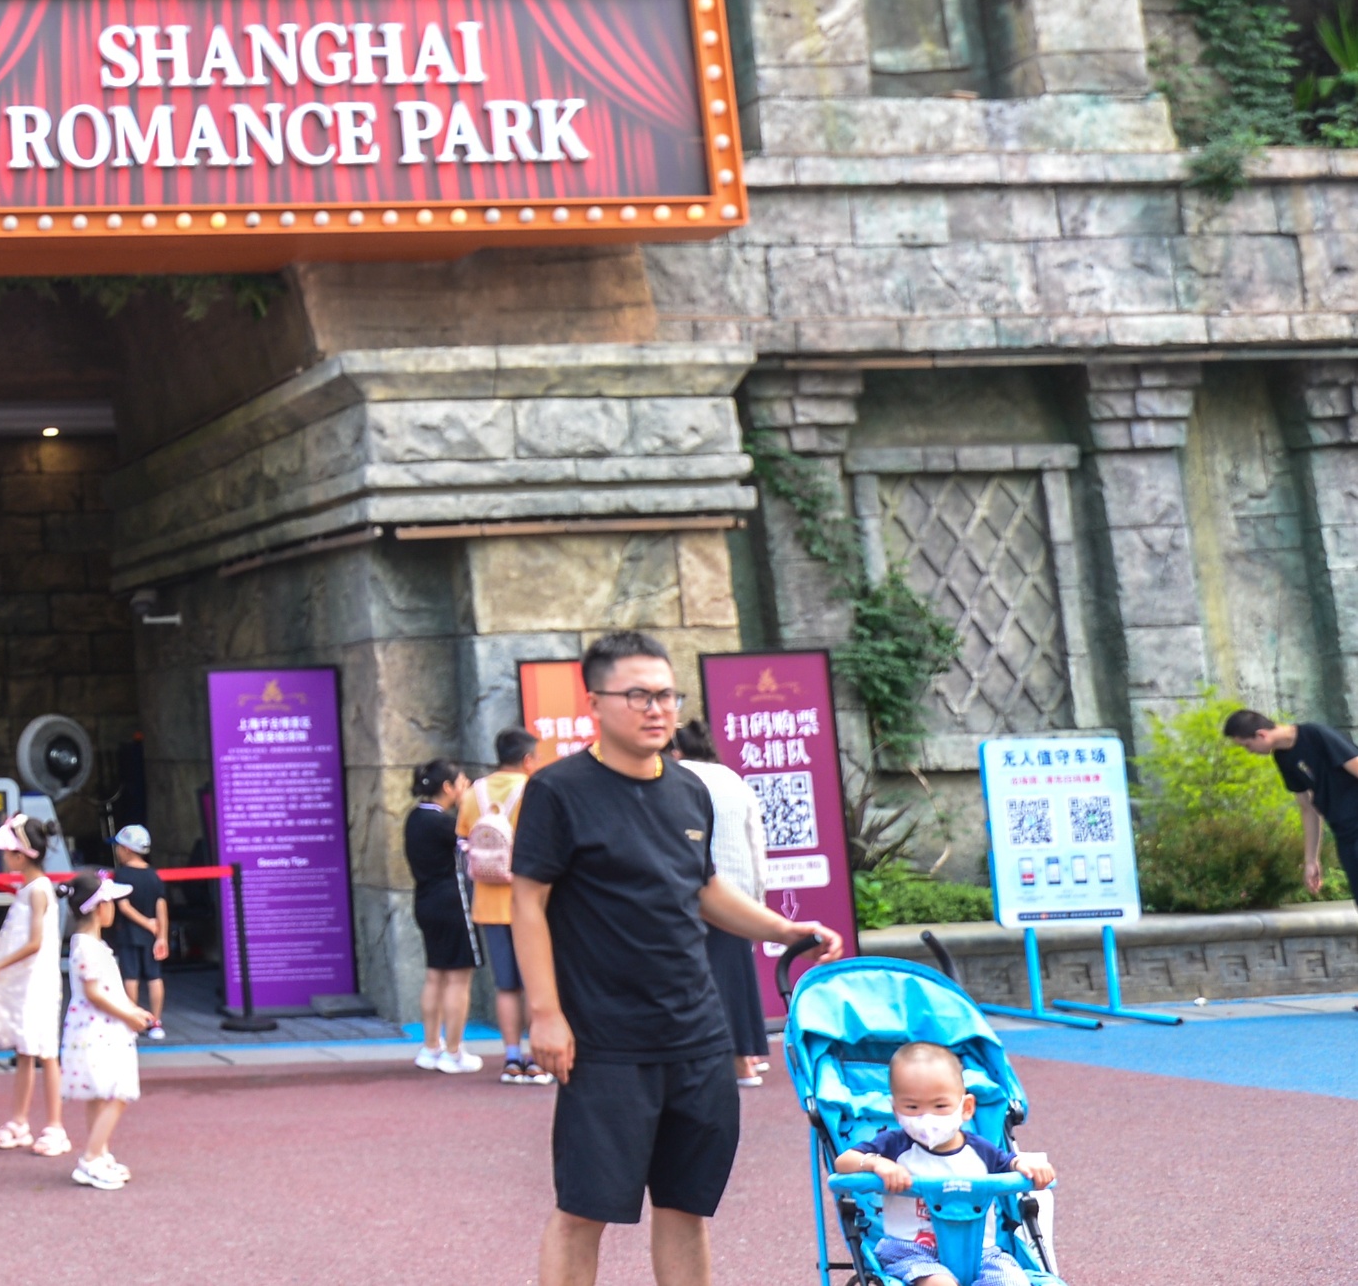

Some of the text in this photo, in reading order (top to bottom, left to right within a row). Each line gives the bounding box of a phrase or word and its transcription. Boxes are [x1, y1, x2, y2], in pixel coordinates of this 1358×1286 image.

[99, 22, 486, 88] SHANGHAI
[6, 98, 589, 169] ROMANCE PARK
[533, 715, 596, 740] 节目单
[724, 707, 819, 741] 扫码购票
[739, 738, 812, 769] 免排队
[1003, 747, 1106, 767] 无人值守车场
[291, 856, 309, 867] Tips
